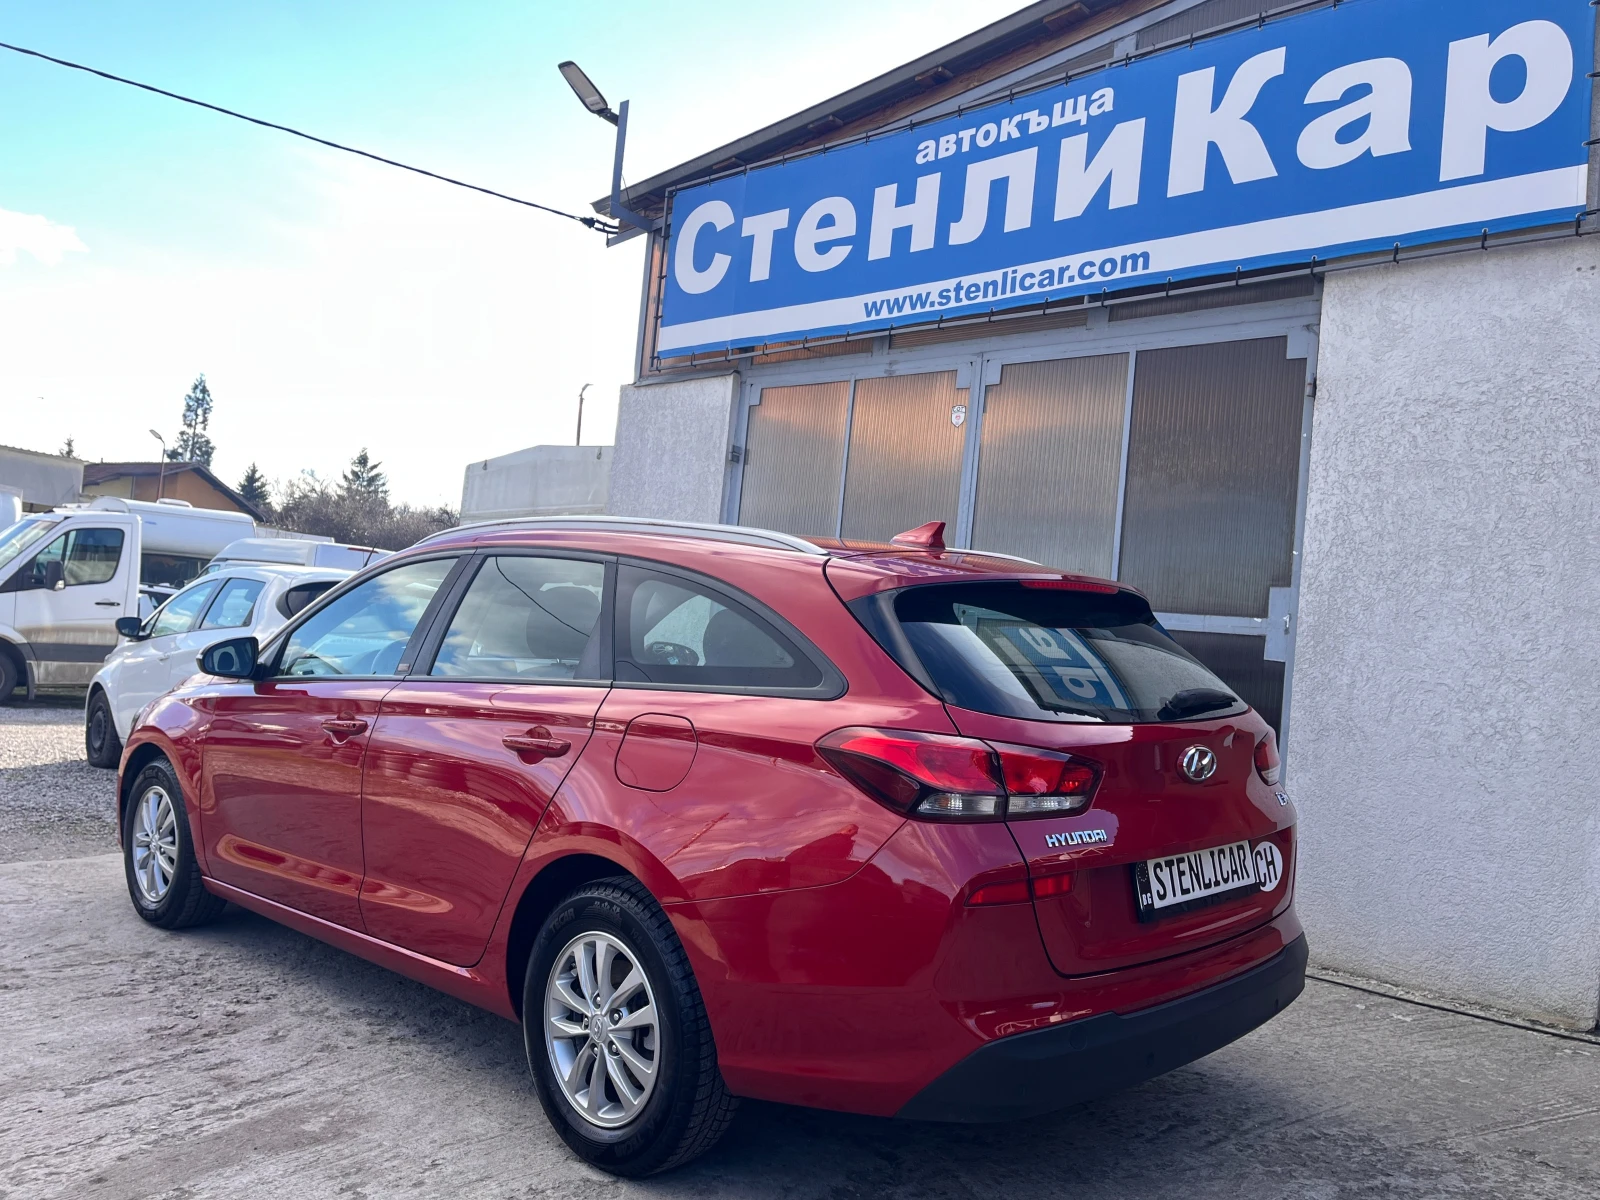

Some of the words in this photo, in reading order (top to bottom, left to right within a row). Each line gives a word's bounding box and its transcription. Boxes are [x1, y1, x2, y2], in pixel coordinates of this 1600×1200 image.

[915, 87, 1114, 165] автокъща
[674, 19, 1574, 295] СтенлиКар
[863, 249, 1151, 319] www.stenlicar.com
[1045, 829, 1107, 848] HYUNDAI
[1254, 845, 1278, 888] CH
[1142, 892, 1152, 906] BG
[1152, 844, 1251, 901] STENLICAR
